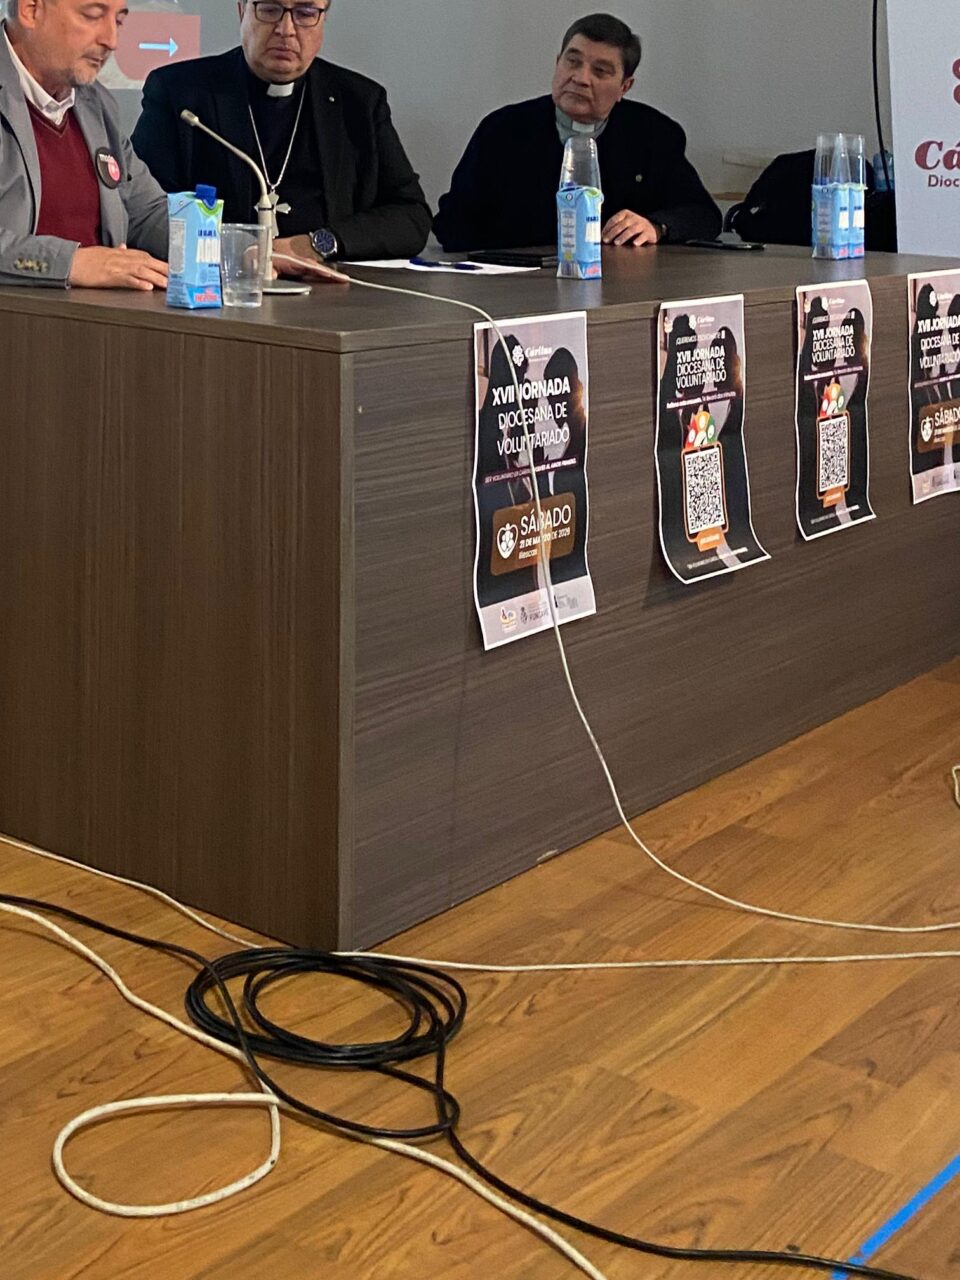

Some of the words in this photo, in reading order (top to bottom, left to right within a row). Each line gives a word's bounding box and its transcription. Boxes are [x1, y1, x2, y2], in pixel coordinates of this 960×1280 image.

[812, 337, 846, 352] DIOCESANA
[845, 336, 854, 347] DE
[676, 350, 692, 364] XVII
[691, 345, 725, 360] JORNADA
[676, 360, 716, 377] DIOCESANA
[716, 357, 725, 370] DE
[675, 370, 727, 389] VOLUNTARIADO
[492, 384, 515, 406] XVII
[498, 405, 554, 430] DIOCESANA
[555, 402, 568, 419] DE
[520, 504, 572, 536] SÁBADO
